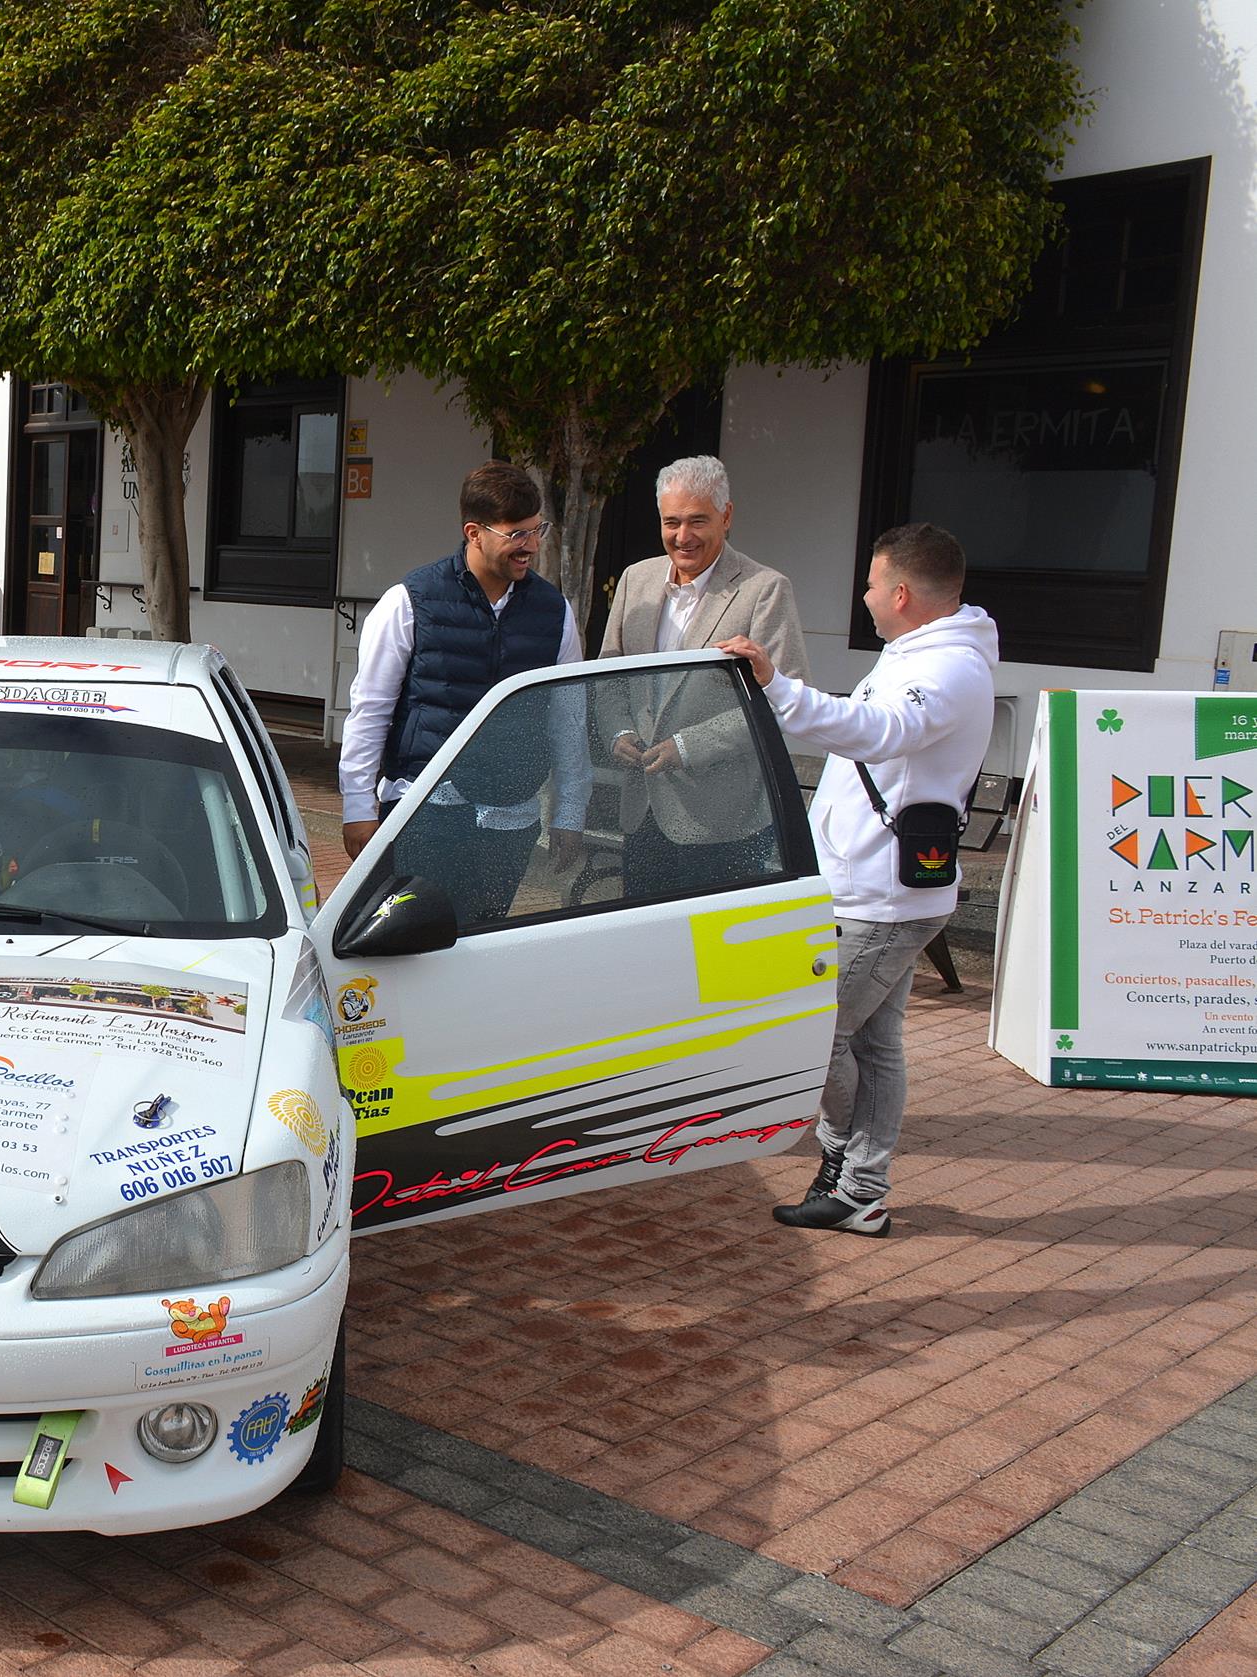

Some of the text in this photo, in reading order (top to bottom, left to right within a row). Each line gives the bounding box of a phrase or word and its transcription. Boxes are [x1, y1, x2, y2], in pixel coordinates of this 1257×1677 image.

[991, 408, 1136, 446] ERMITA
[347, 468, 369, 493] Bc
[1231, 715, 1248, 727] 16
[1106, 823, 1129, 841] DEL
[1109, 879, 1252, 895] LANZAR
[1179, 939, 1208, 950] Plaza
[1209, 940, 1227, 951] del
[1209, 954, 1247, 966] Puerto
[1104, 972, 1257, 989] Conciertos, pasacalles,
[1126, 990, 1191, 1005] Concerts,
[1194, 993, 1251, 1007] parades,
[1204, 1012, 1254, 1022] Un evento
[102, 1014, 136, 1030] La
[141, 1019, 219, 1046] Marisma
[1201, 1025, 1217, 1035] An
[1219, 1026, 1246, 1035] event
[32, 1034, 52, 1044] del
[54, 1035, 102, 1048] Carmen
[150, 1047, 173, 1058] 928
[176, 1051, 198, 1063] 510
[201, 1056, 224, 1068] 460
[136, 1037, 157, 1048] Los
[160, 1041, 207, 1058] Pocillos
[1145, 1041, 1257, 1056] www.sanpatrickpu
[13, 1082, 72, 1094] LANZAROTE
[35, 1101, 53, 1112] 77
[353, 1105, 391, 1121] Tías
[1, 1139, 18, 1151] 03
[22, 1142, 39, 1154] 53
[89, 1124, 217, 1166] TRANSPORTES
[125, 1143, 207, 1177] NUÑEZ
[119, 1154, 235, 1202] 606 016 507
[173, 1336, 236, 1354] LUDOTECA INFANTIL
[208, 1357, 221, 1367] en
[222, 1353, 232, 1363] la
[233, 1348, 263, 1364] panza
[36, 1440, 55, 1475] sparco
